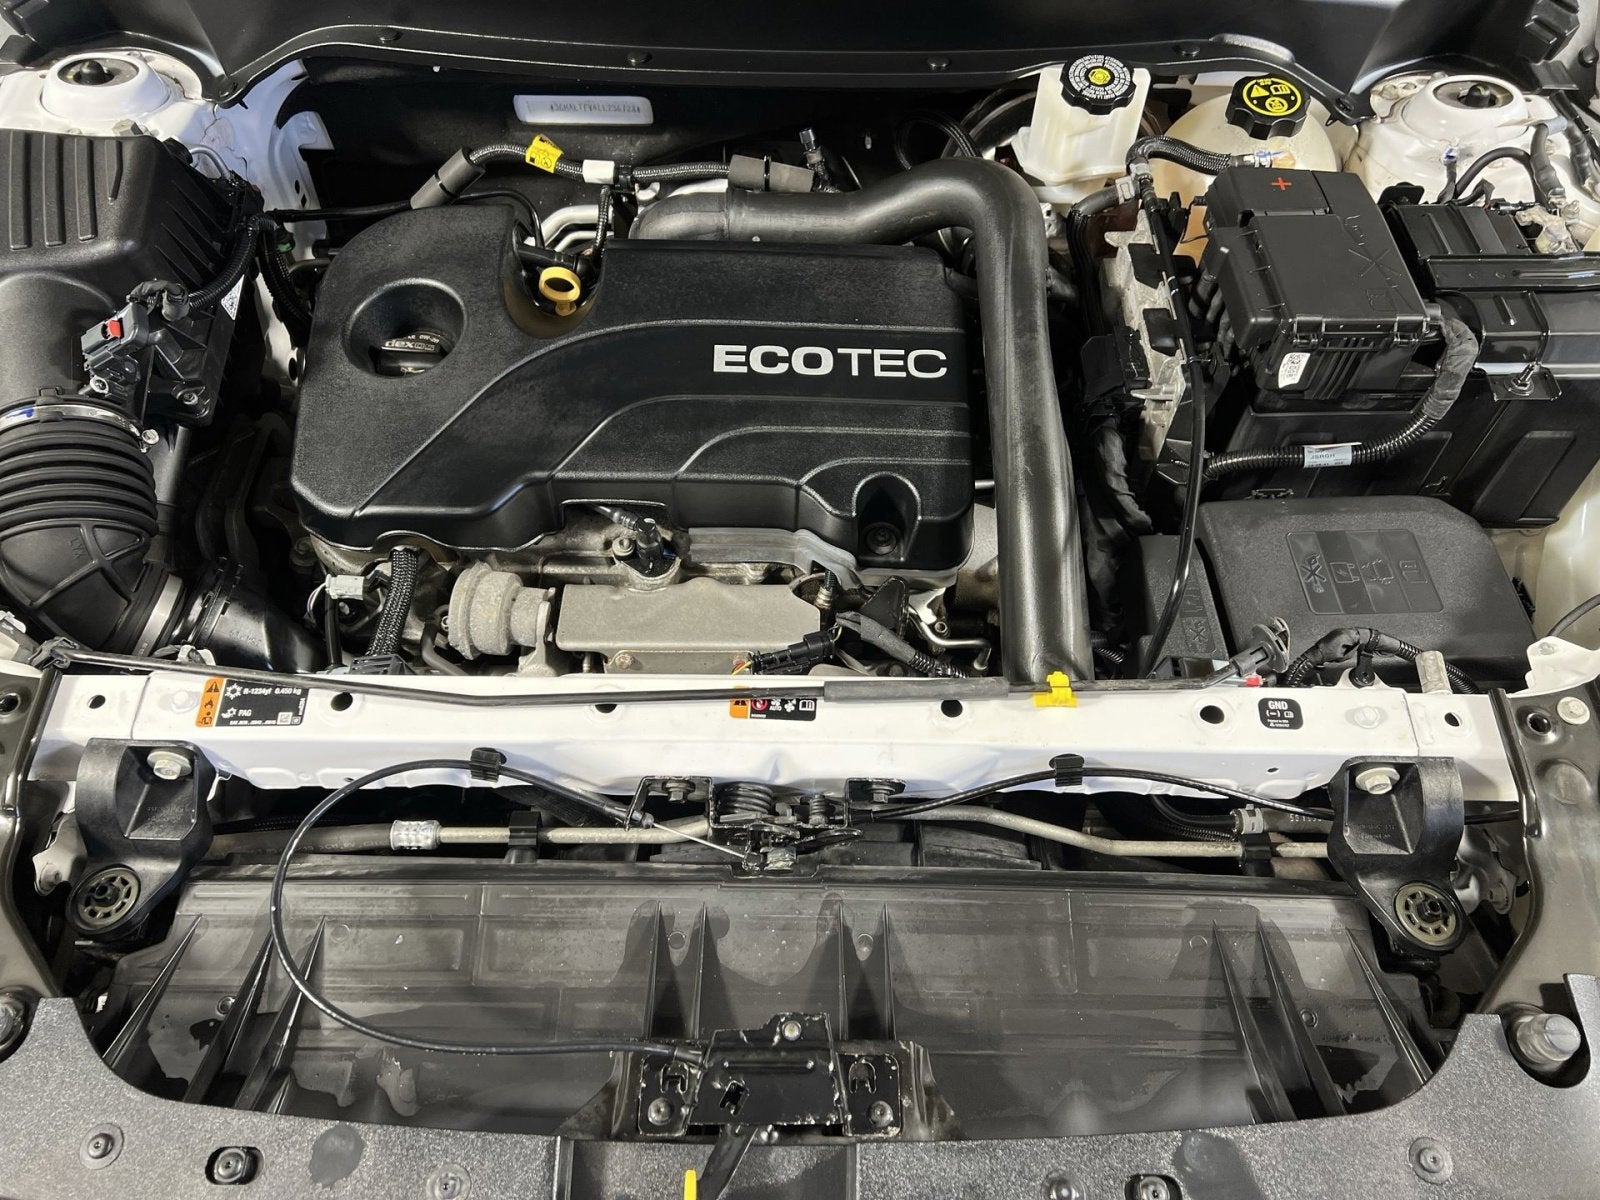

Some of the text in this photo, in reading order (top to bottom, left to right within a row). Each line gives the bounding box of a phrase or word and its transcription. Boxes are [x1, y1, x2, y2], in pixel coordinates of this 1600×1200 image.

[385, 339, 435, 351] dexos
[713, 344, 948, 379] ECOTEC
[243, 688, 272, 696] R-1234yf
[292, 687, 302, 696] kg
[1268, 701, 1288, 710] GND
[238, 709, 252, 717] PAG
